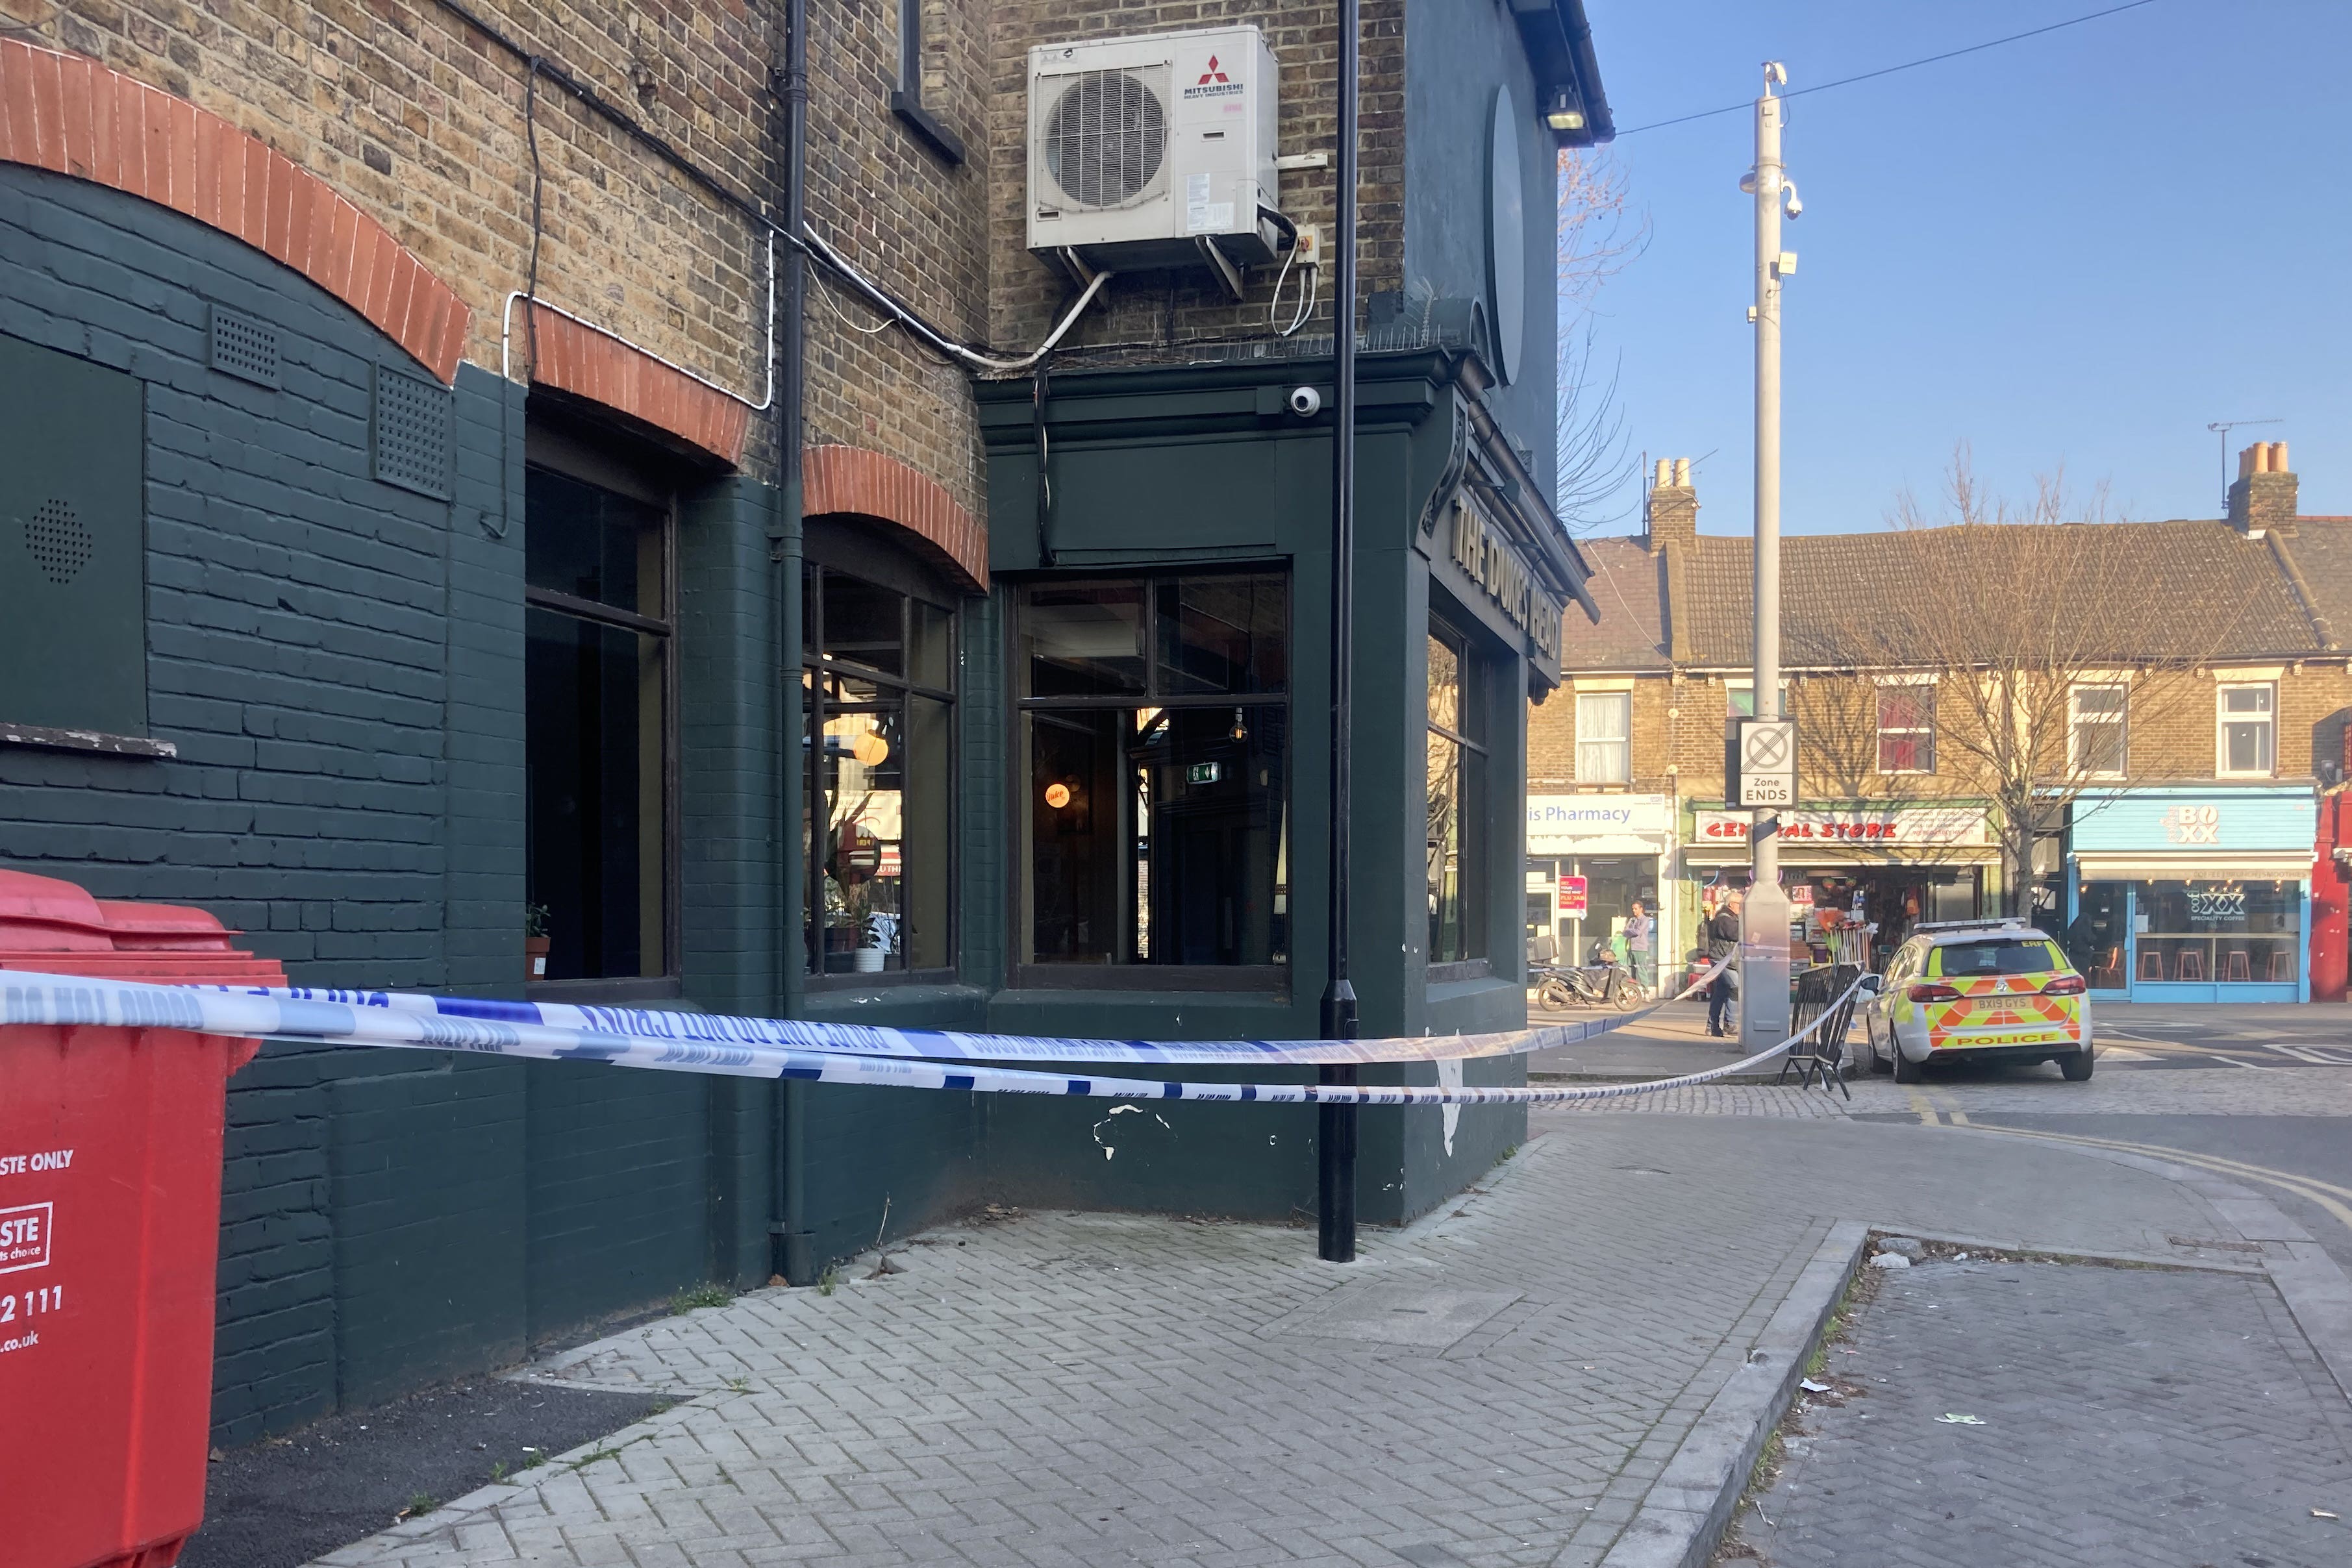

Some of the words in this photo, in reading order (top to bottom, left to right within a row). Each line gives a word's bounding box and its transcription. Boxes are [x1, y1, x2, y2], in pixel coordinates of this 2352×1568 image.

[1184, 84, 1244, 95] MITSUBISHI
[1454, 495, 1486, 585] THE
[1486, 534, 1529, 631] DUKES
[1529, 586, 1557, 660] HEAD
[1753, 778, 1780, 787] Zone
[1745, 790, 1787, 801] ENDS
[1527, 807, 1541, 821] is
[1545, 806, 1631, 824] Pharmacy
[1706, 823, 1814, 838] GENAL
[1820, 823, 1897, 838] STORE
[1979, 999, 2003, 1009] BX19
[2005, 998, 2027, 1007] GYS
[1957, 1034, 2056, 1045] POLICE
[0, 1155, 27, 1176] STE
[30, 1149, 73, 1172] ONLY
[0, 1217, 39, 1247] STE
[0, 1295, 16, 1323] 2
[25, 1285, 62, 1317] 111
[0, 1330, 39, 1353] .co.uk
